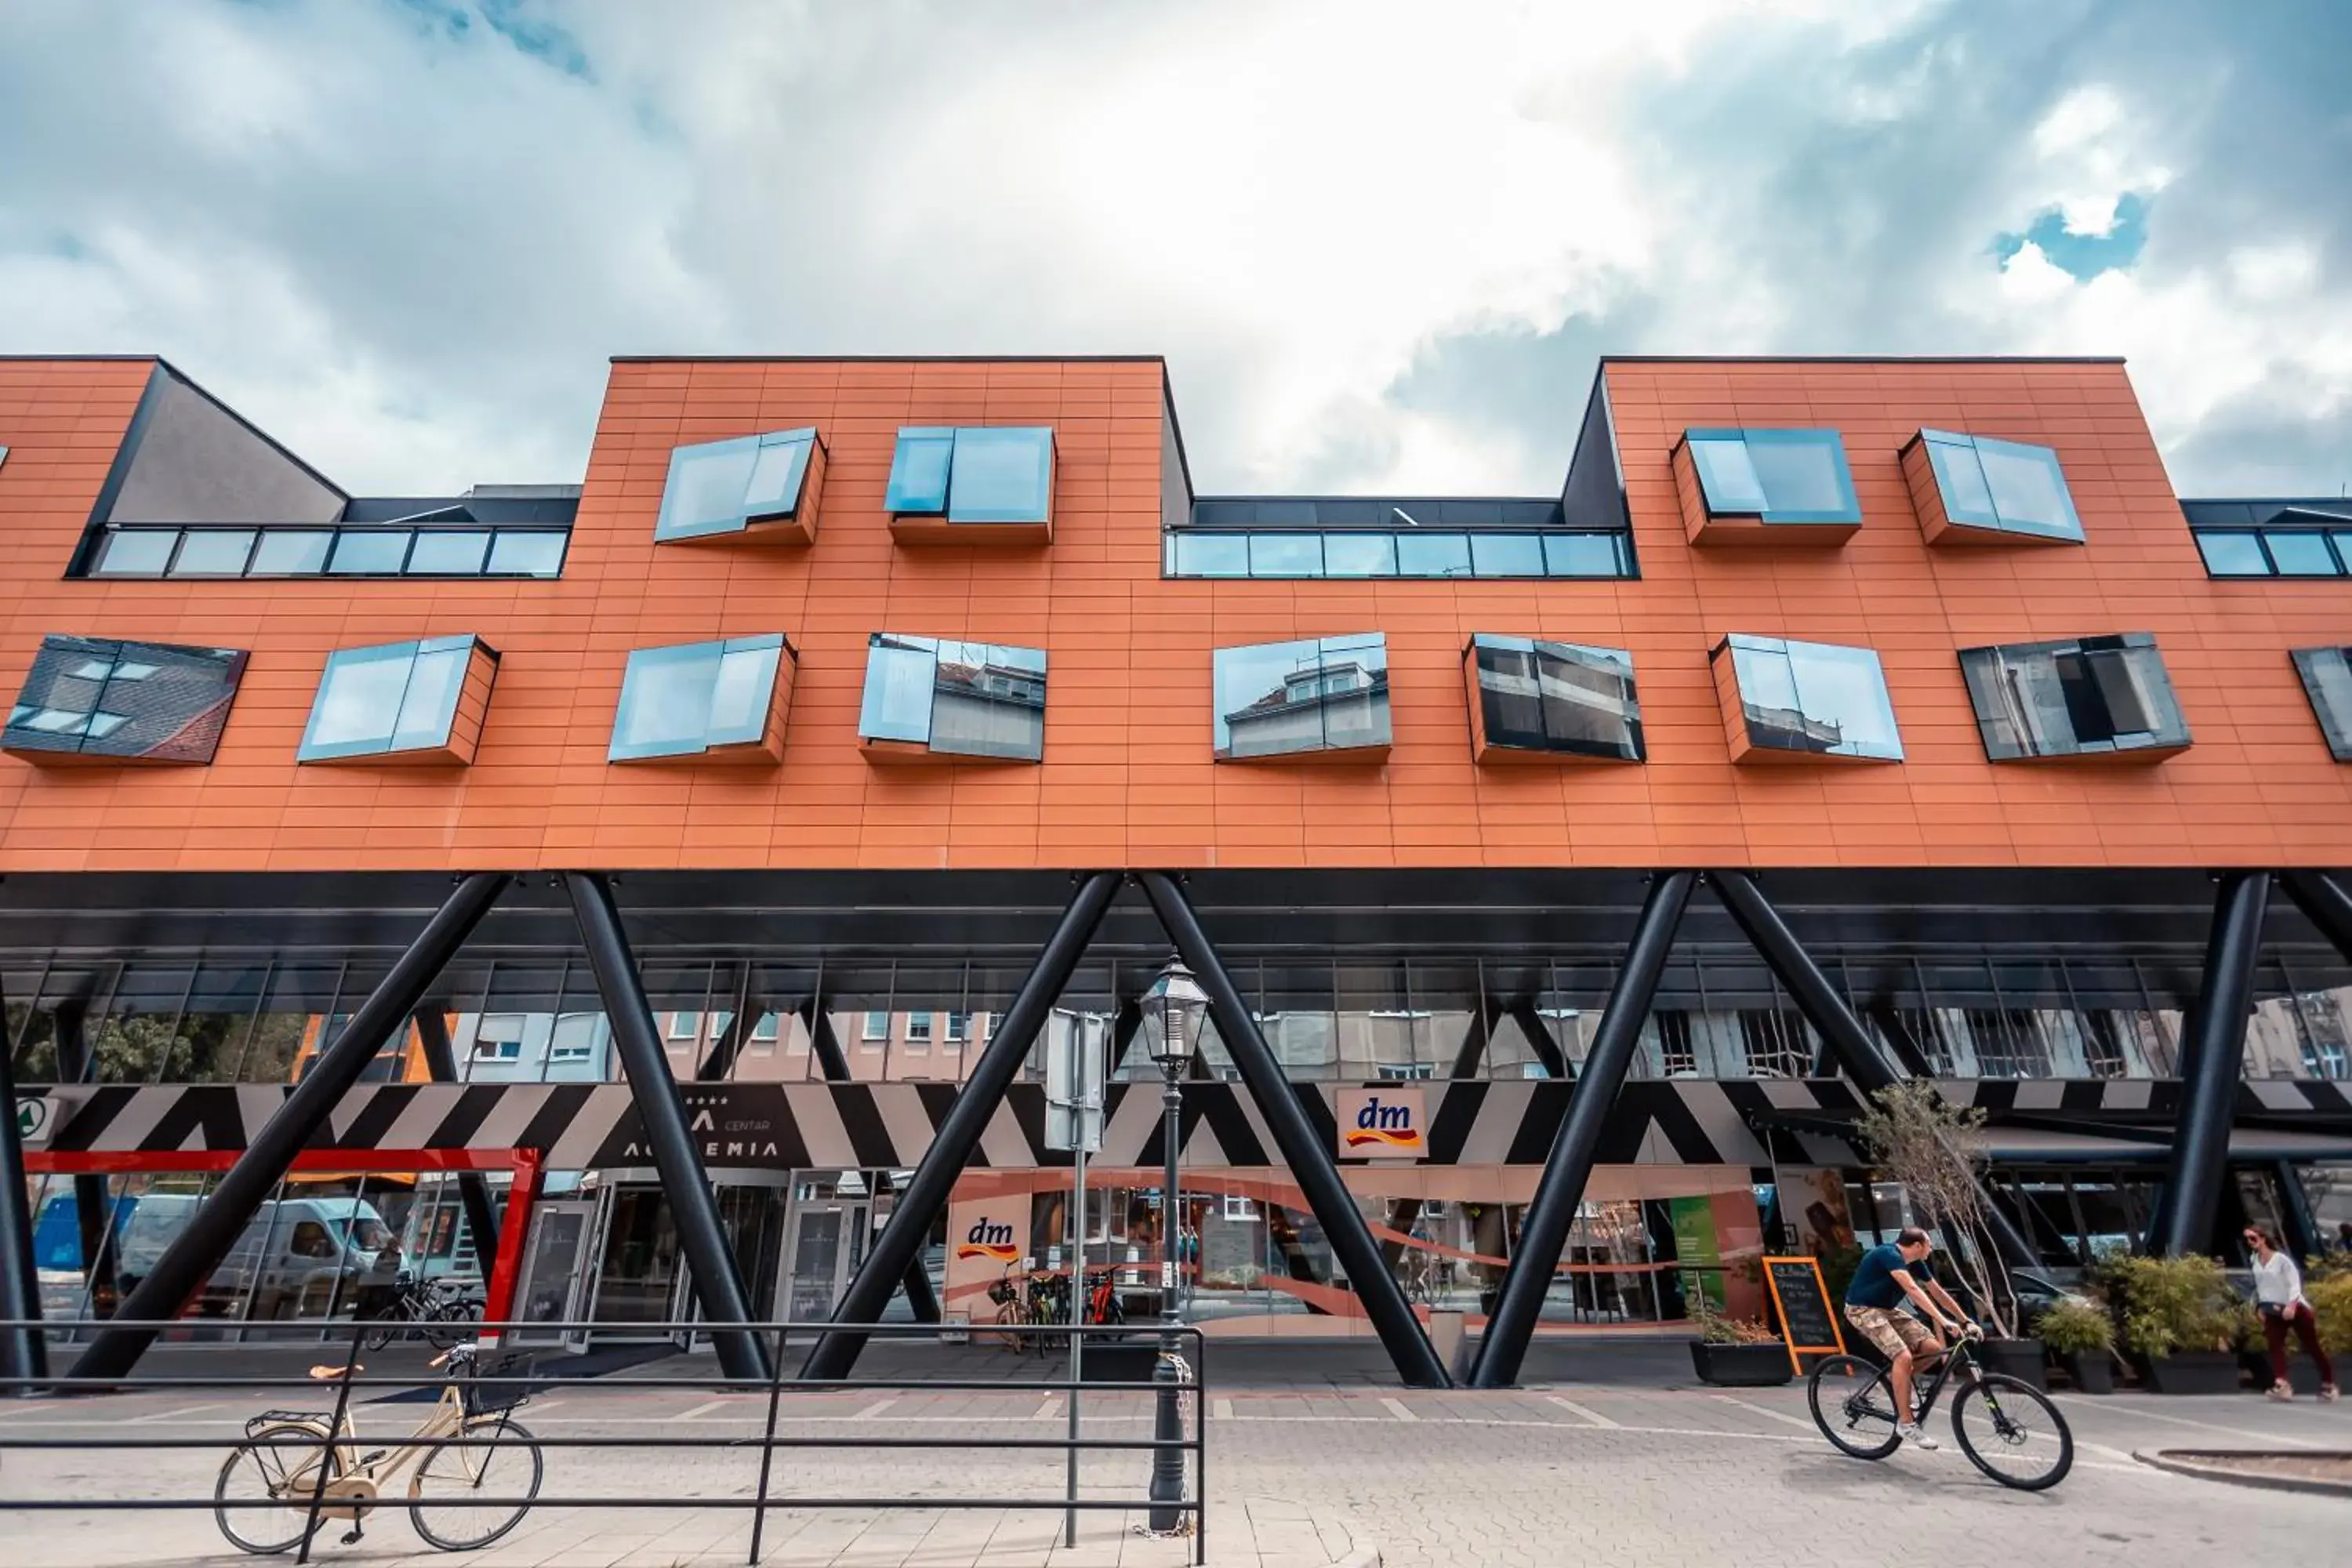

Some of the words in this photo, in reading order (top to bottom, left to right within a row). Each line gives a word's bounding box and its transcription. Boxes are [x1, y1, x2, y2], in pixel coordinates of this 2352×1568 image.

[1358, 1098, 1410, 1129] dm
[724, 1120, 771, 1131] CENTAR
[623, 1142, 778, 1156] AEMIA
[968, 1217, 1012, 1243] dm
